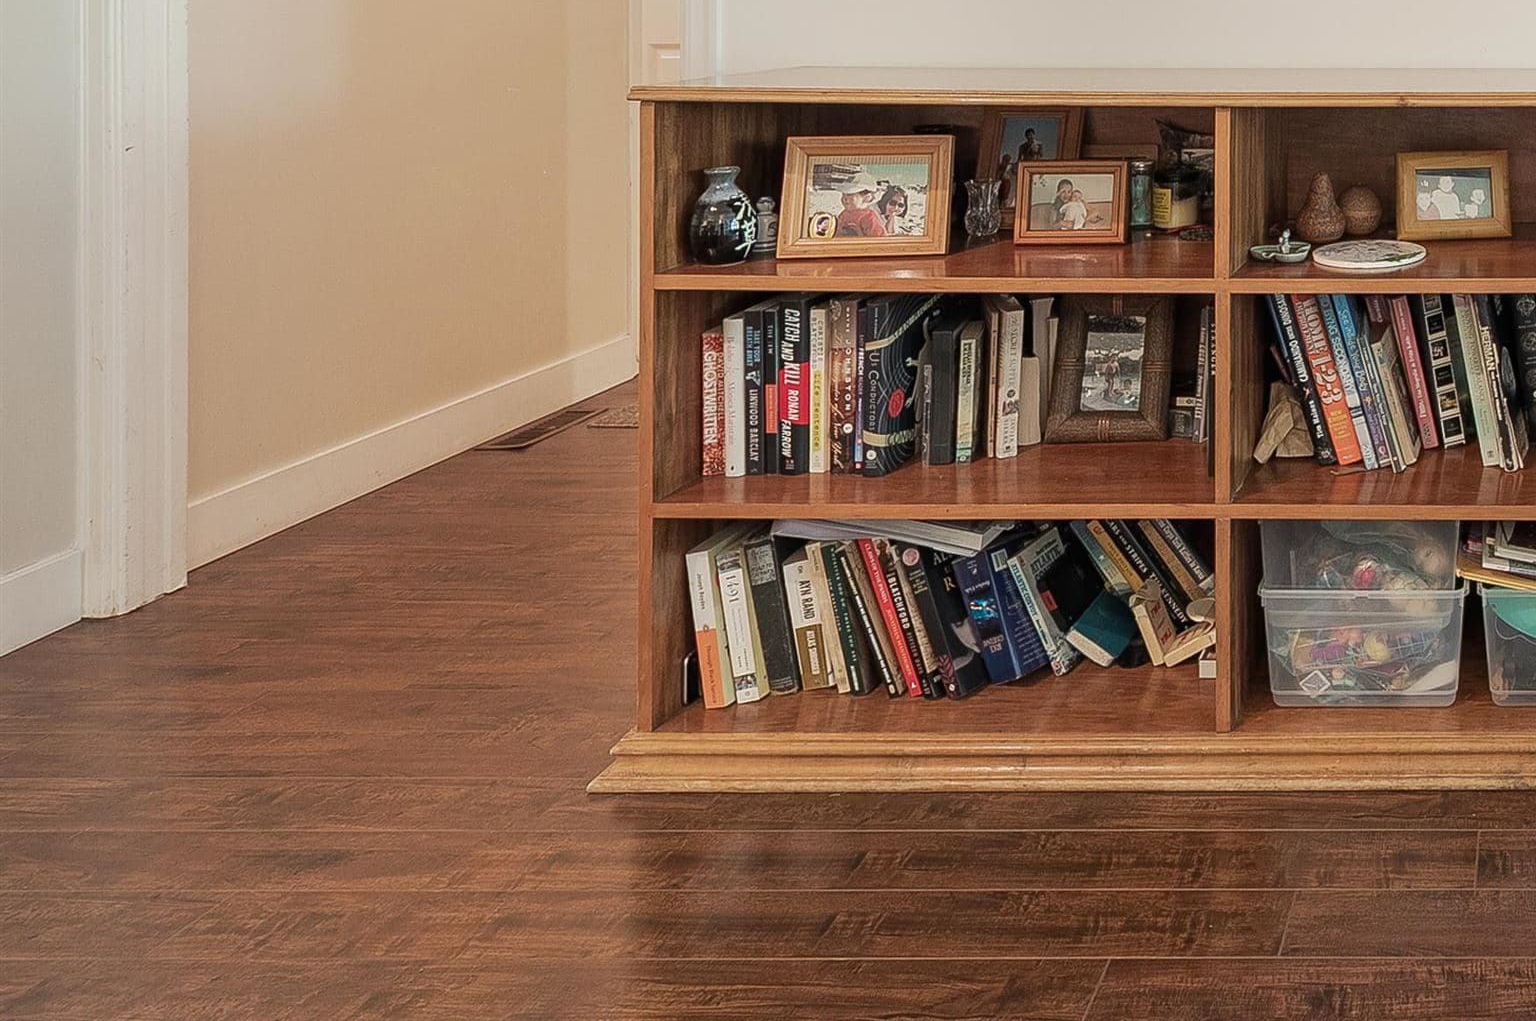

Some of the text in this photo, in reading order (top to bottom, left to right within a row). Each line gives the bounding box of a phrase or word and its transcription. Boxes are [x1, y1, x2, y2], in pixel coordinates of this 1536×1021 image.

[781, 308, 801, 385] CATCH AND KILL
[1301, 298, 1329, 353] HOME
[1324, 309, 1338, 335] BYNG
[1338, 308, 1351, 325] See
[1350, 349, 1363, 370] Your
[1480, 326, 1496, 371] HERMAN
[1288, 340, 1308, 383] CAMINANDO
[1309, 353, 1344, 406] 1-2-3
[1330, 336, 1355, 393] SECONDARY
[704, 351, 717, 444] GHOSTWRITTEN
[781, 389, 799, 457] RONAN FARROW
[813, 373, 821, 448] Life Sentence
[749, 389, 759, 462] LINWOOD BARCLAY
[1125, 544, 1149, 573] STRIPES
[726, 574, 741, 603] 1491
[798, 580, 815, 619] AYN RAND
[877, 583, 889, 604] PANDA
[887, 576, 911, 629] BLATCHFORD
